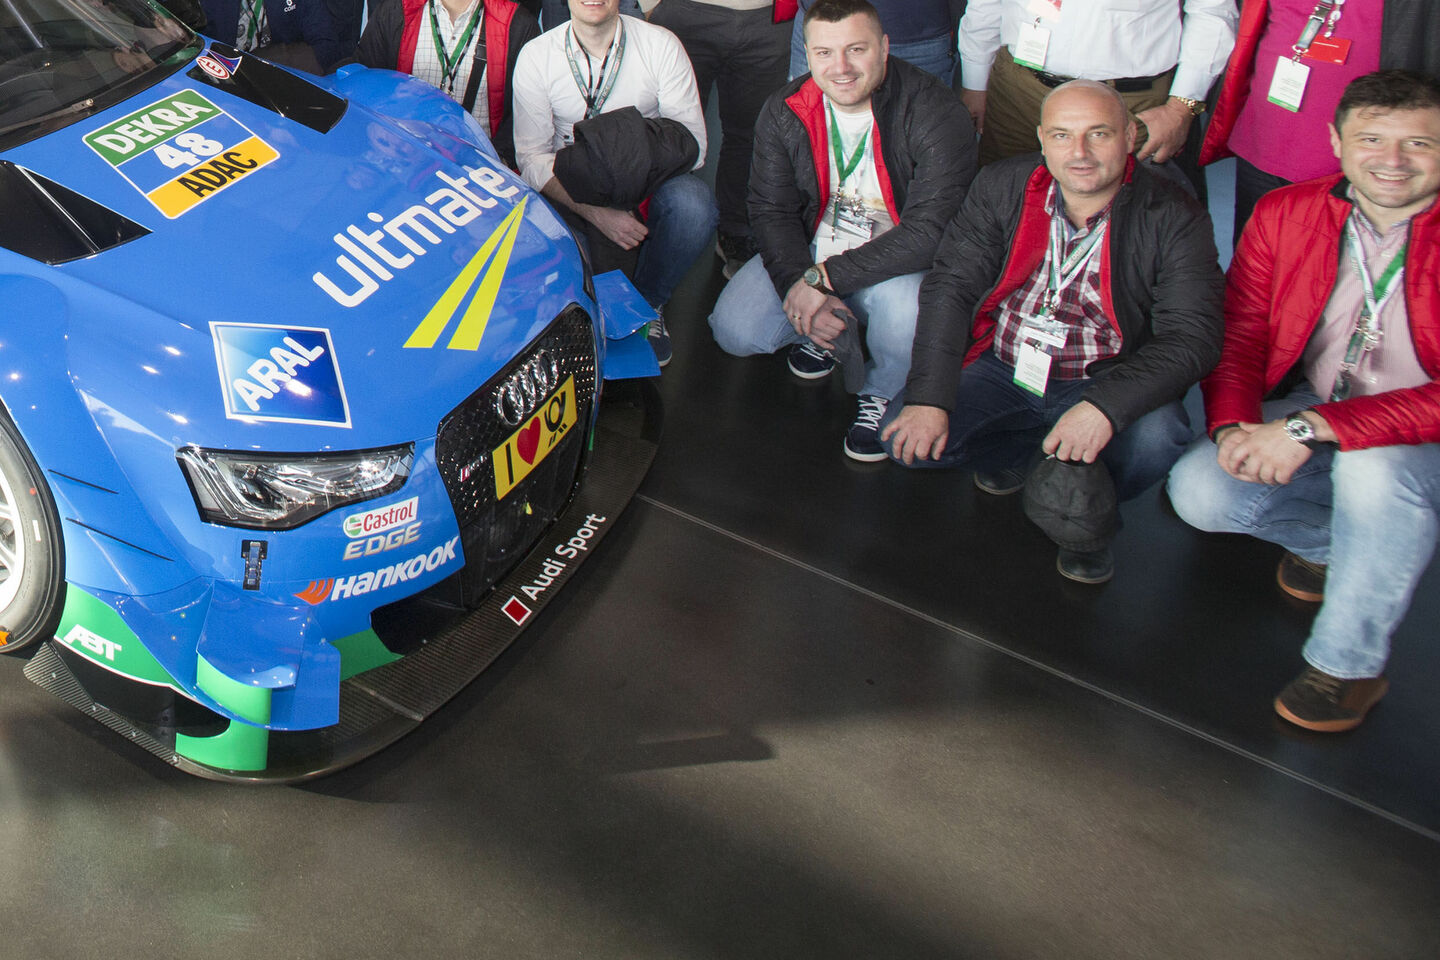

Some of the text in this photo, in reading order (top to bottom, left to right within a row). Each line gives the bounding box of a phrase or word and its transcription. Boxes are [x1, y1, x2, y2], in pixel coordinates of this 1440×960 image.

[93, 100, 213, 155] DEKRA
[153, 132, 224, 169] 48
[177, 151, 258, 197] ADAC
[312, 166, 519, 308] ultimate
[233, 336, 325, 411] ARAL
[363, 501, 413, 532] Castrol
[343, 521, 422, 560] EDGE
[521, 513, 607, 601] Audi Sport
[63, 624, 122, 662] ABT
